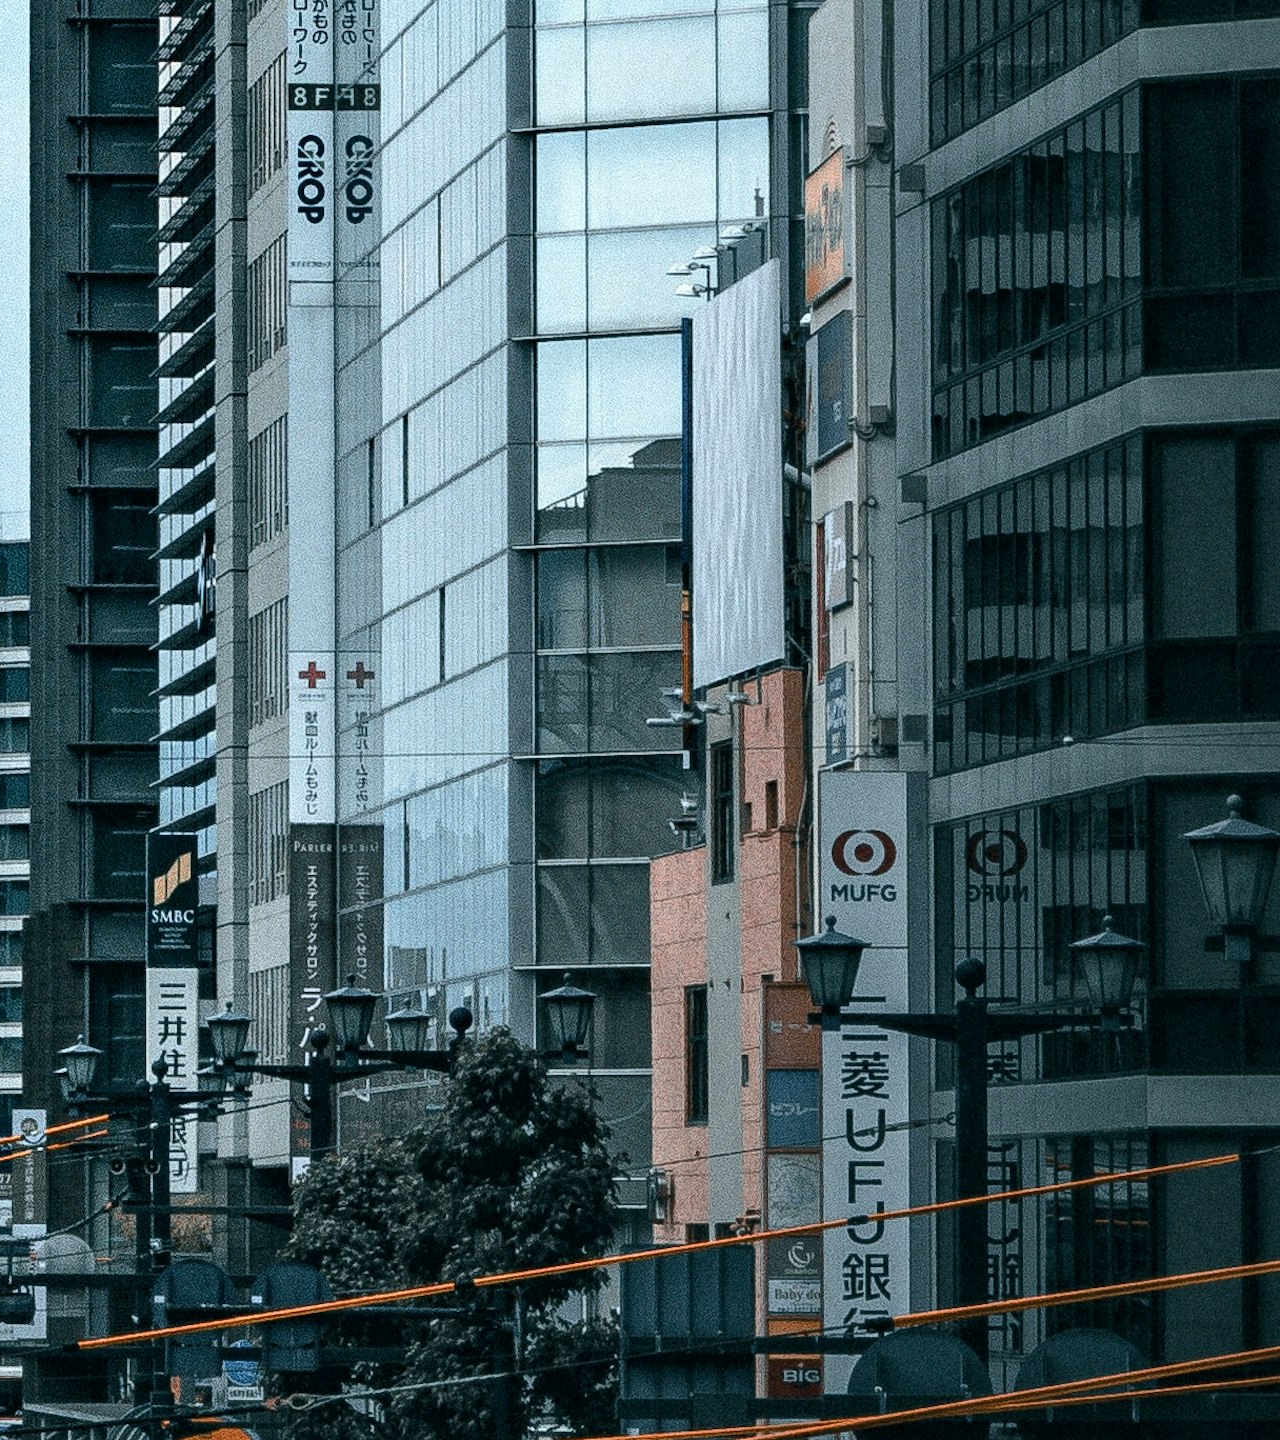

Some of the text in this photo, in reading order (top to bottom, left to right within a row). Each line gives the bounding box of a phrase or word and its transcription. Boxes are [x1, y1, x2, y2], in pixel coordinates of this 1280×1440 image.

[297, 134, 325, 224] GROP
[305, 711, 320, 816] 献血ルームもみじ
[294, 841, 333, 853] PARLER
[151, 909, 195, 924] SMBC
[831, 884, 897, 903] MUFG
[307, 865, 319, 980] エステティックサロン
